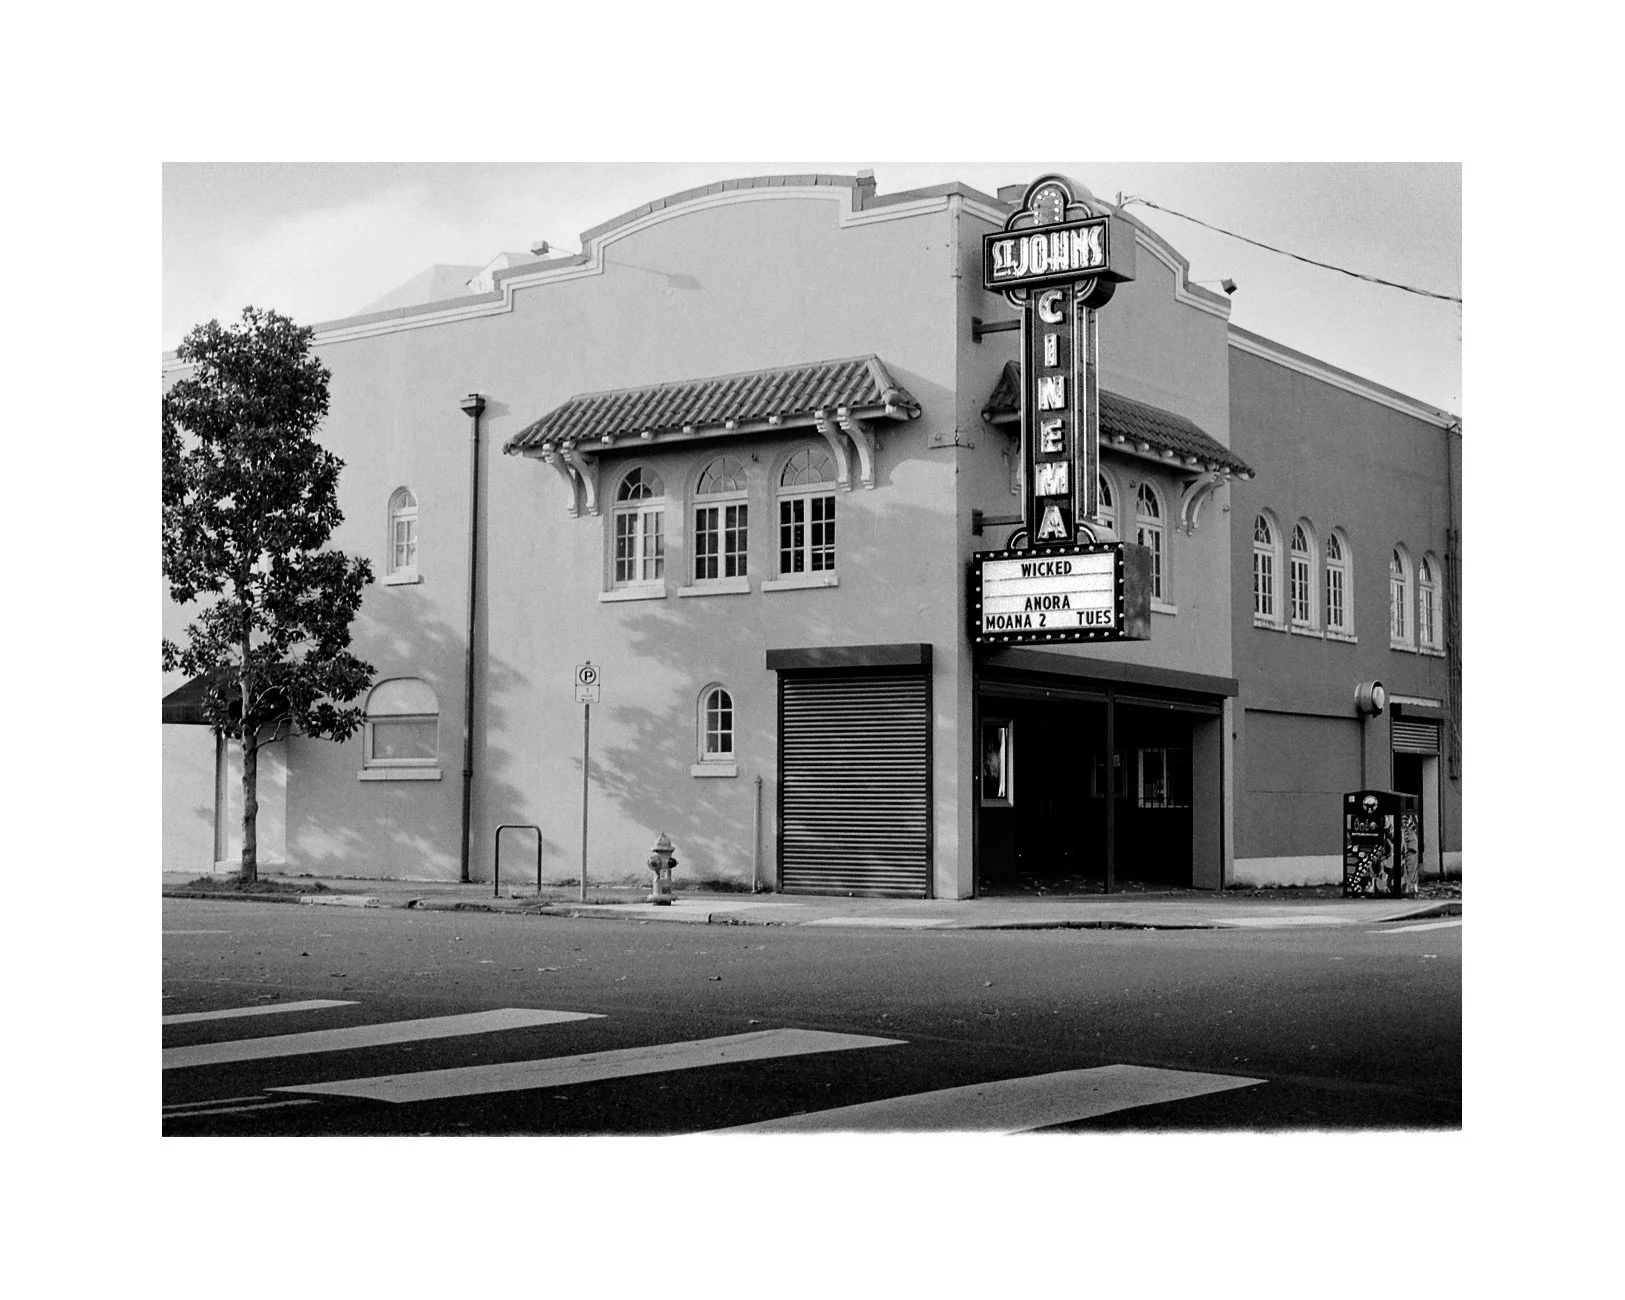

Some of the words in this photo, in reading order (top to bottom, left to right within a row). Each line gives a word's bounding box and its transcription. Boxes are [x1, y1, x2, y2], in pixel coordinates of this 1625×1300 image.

[1012, 226, 1103, 278] JOHNS
[1036, 289, 1068, 539] CINEMA
[1021, 561, 1072, 577] WICKED
[1025, 595, 1071, 611] ANORA
[986, 614, 1032, 630] MOANA
[1039, 614, 1046, 627] 2
[1077, 610, 1111, 626] TUES
[584, 670, 593, 681] P
